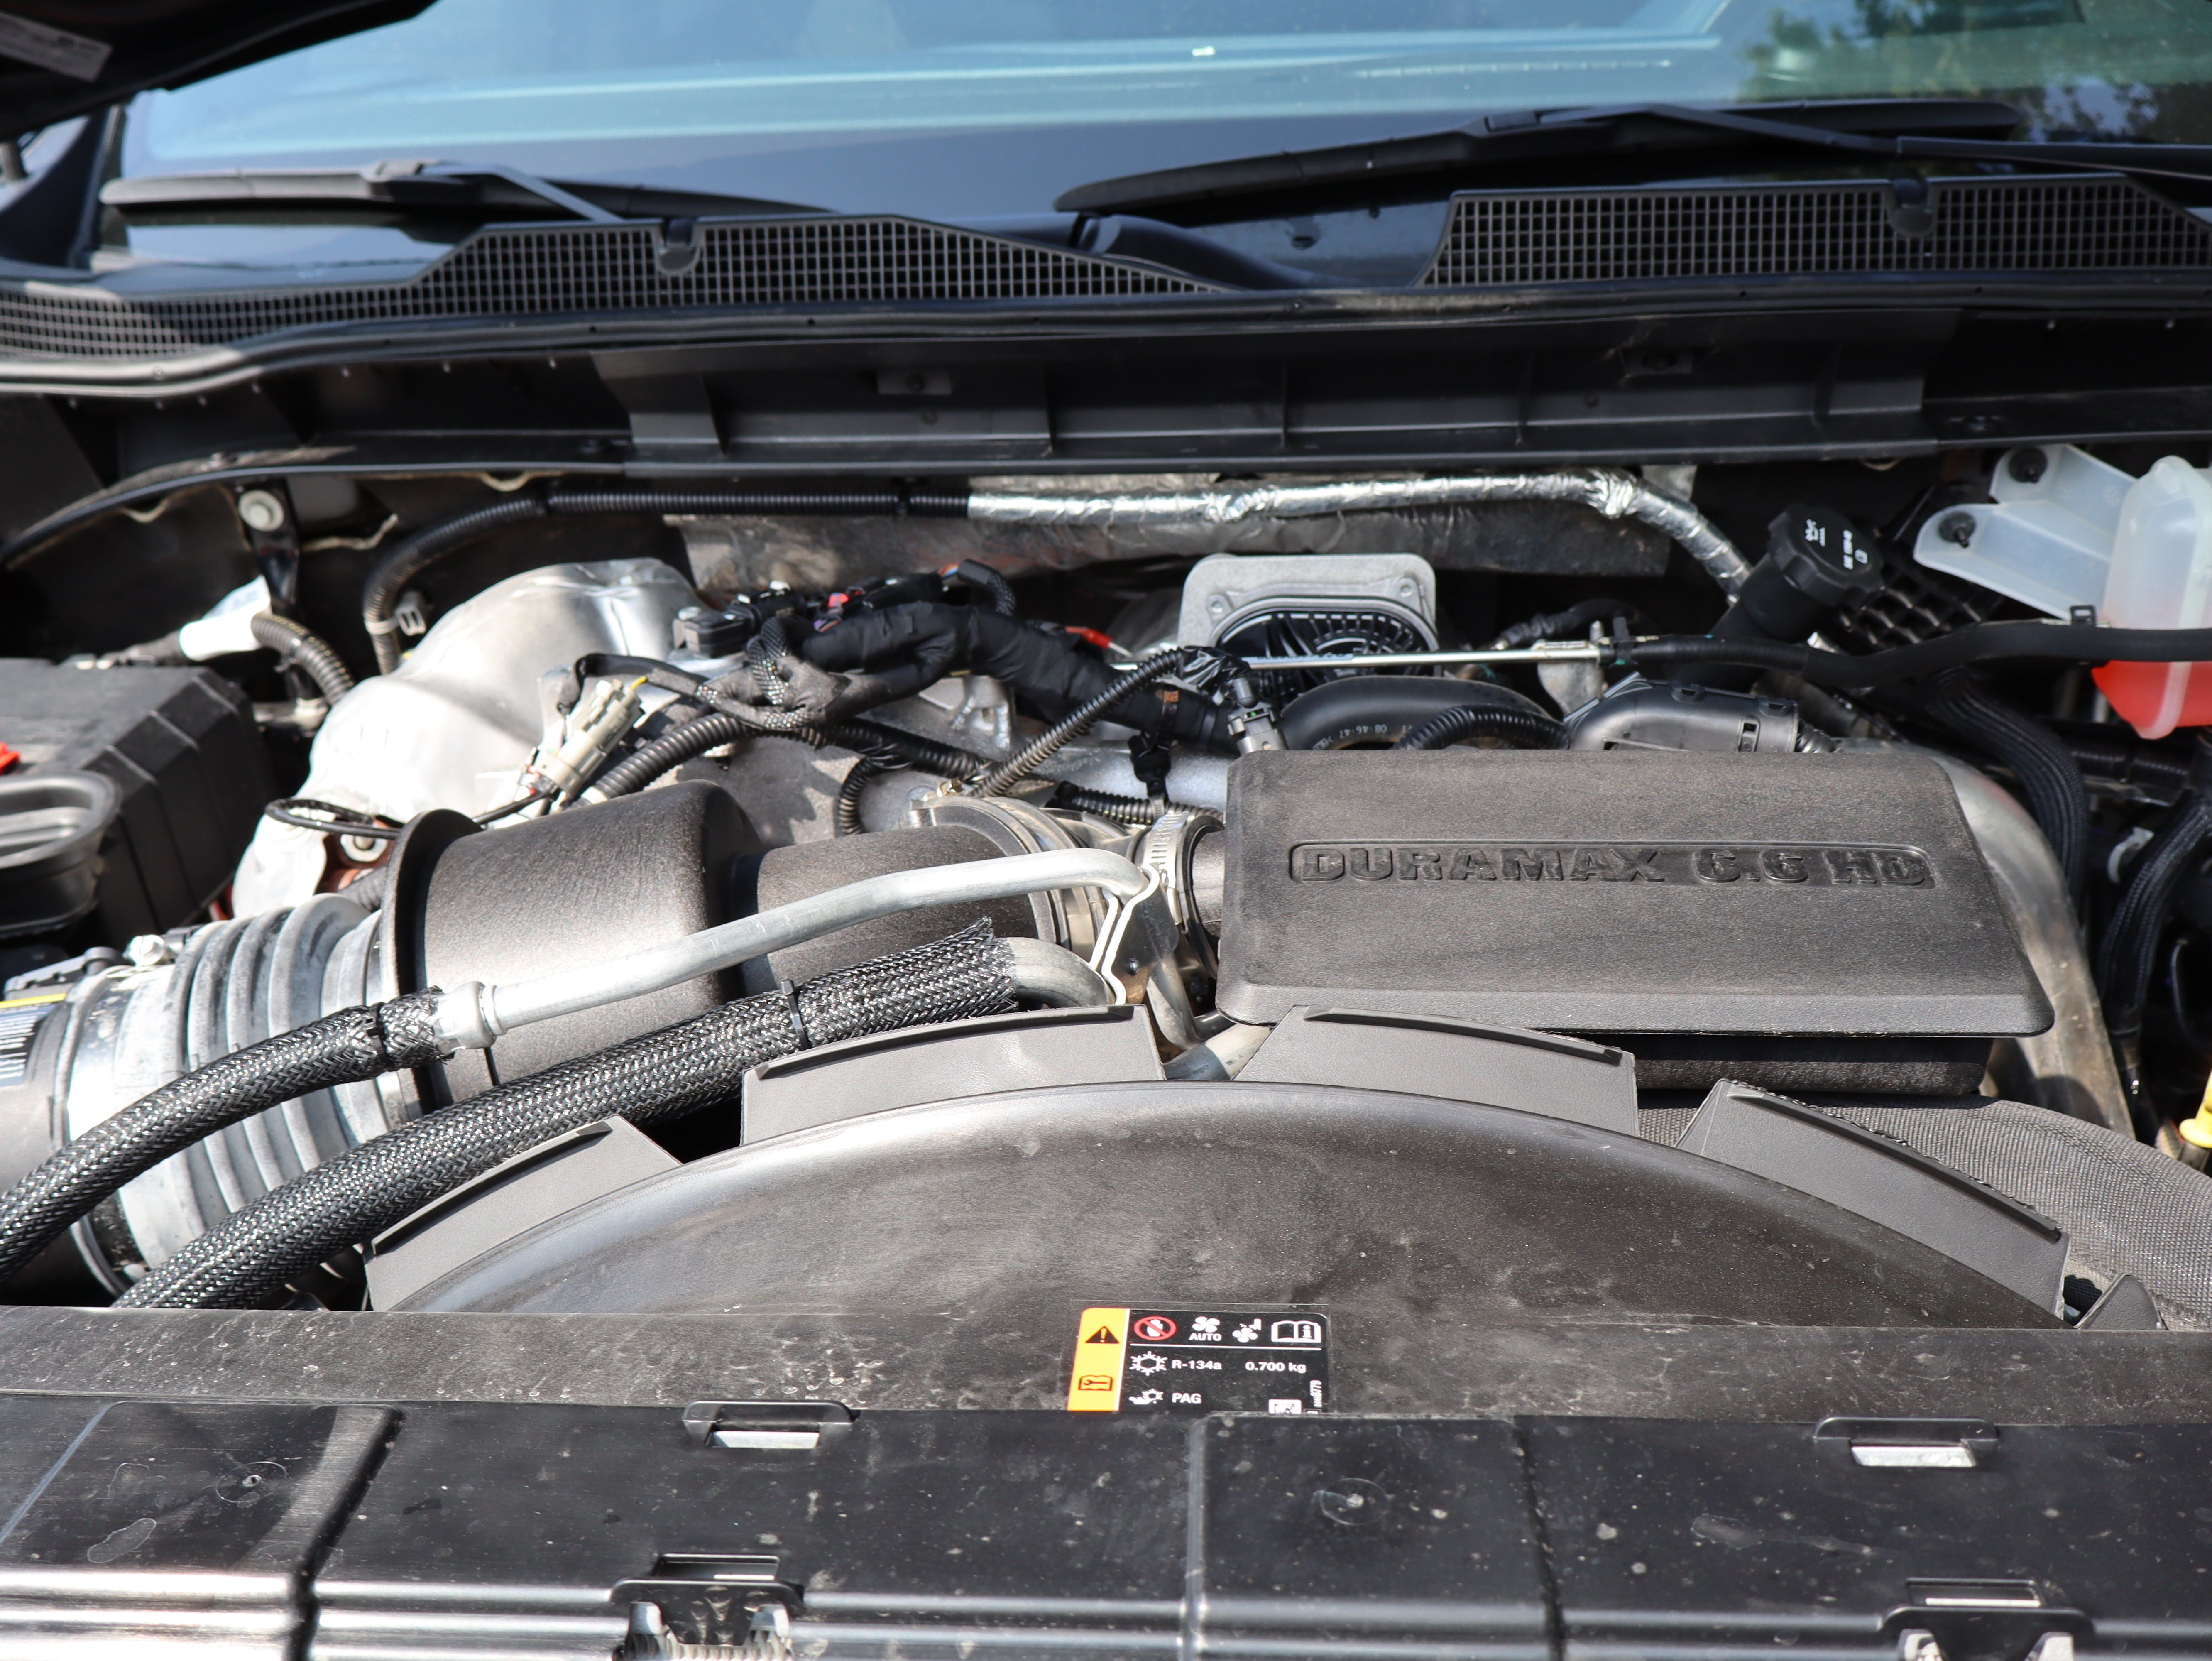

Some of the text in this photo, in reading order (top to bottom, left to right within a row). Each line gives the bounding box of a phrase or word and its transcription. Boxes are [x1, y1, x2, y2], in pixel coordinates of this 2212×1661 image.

[1301, 846, 1927, 886] DURAMAX 6.6 HD
[1189, 1333, 1222, 1341] AUTO
[1172, 1359, 1307, 1374] R-134a 0.700 kg
[1172, 1392, 1201, 1404] PAG
